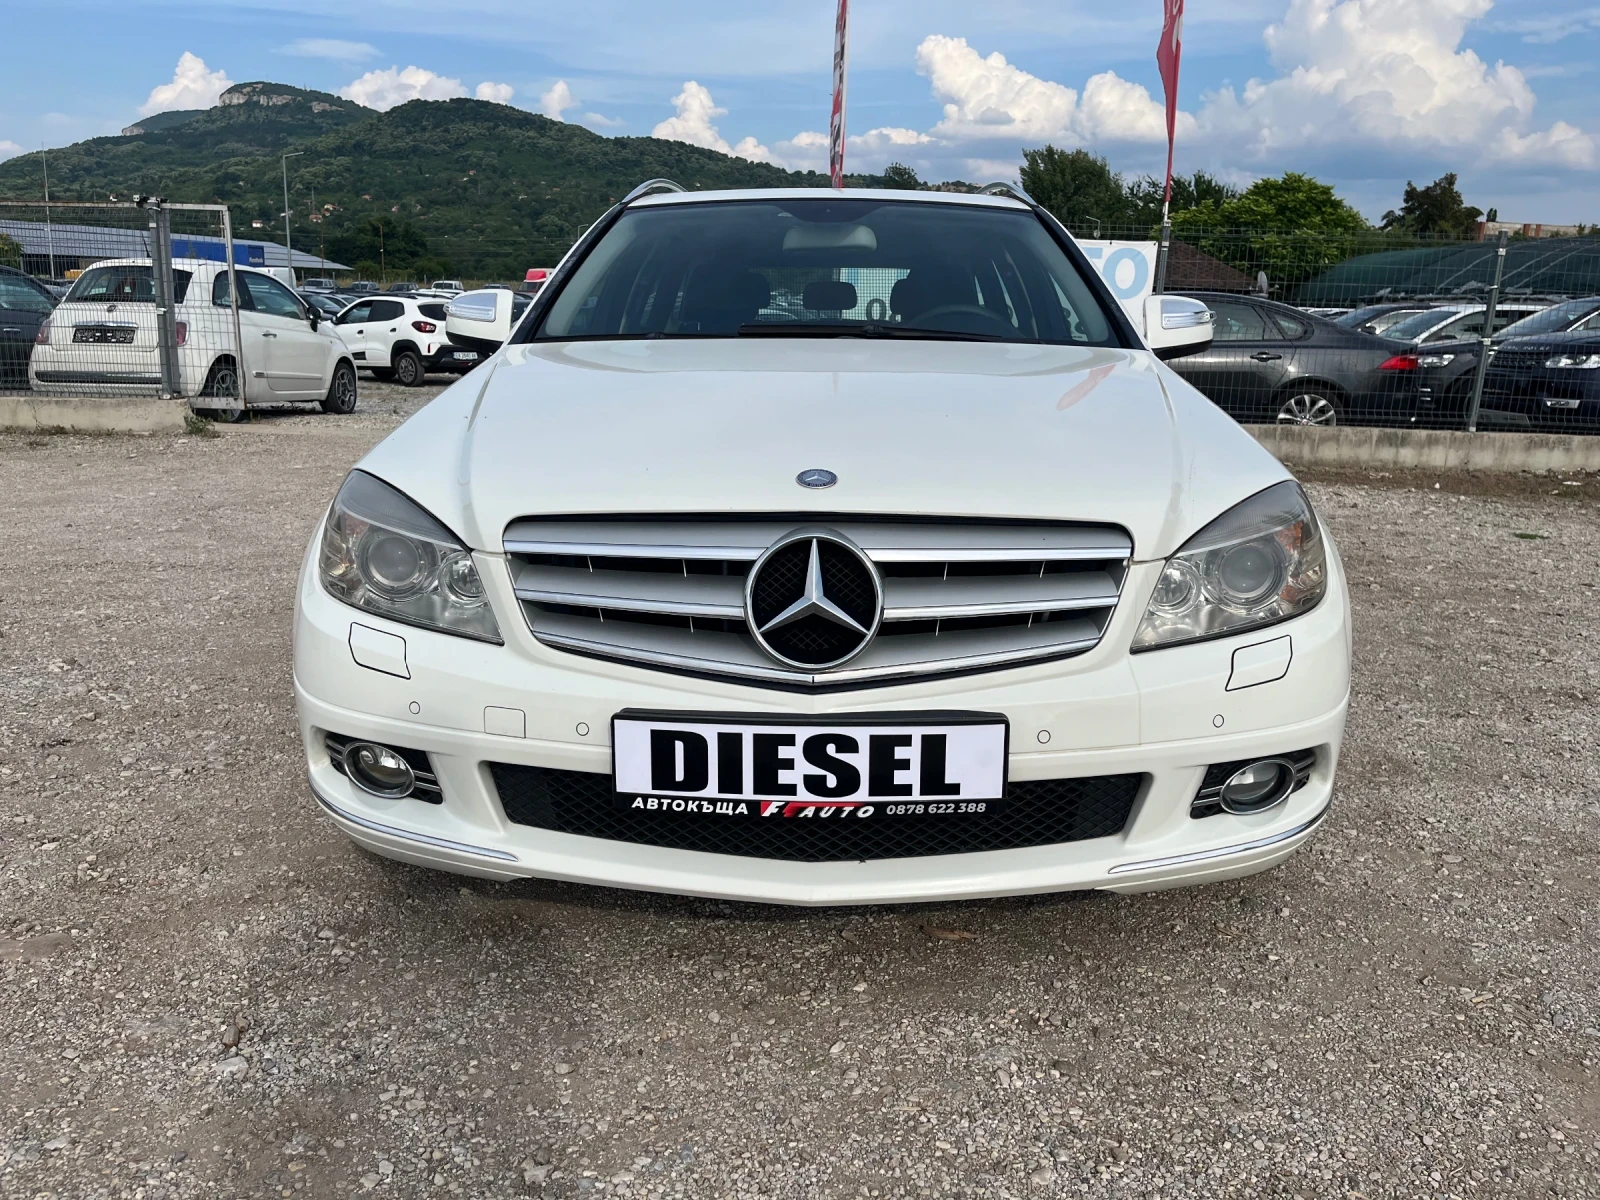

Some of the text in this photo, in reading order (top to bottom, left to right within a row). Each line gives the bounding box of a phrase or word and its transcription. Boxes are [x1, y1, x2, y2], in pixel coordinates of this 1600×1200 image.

[650, 729, 961, 798] DIESEL
[631, 797, 749, 816] АВТОКЪЩА
[886, 802, 987, 815] 0878 622 388
